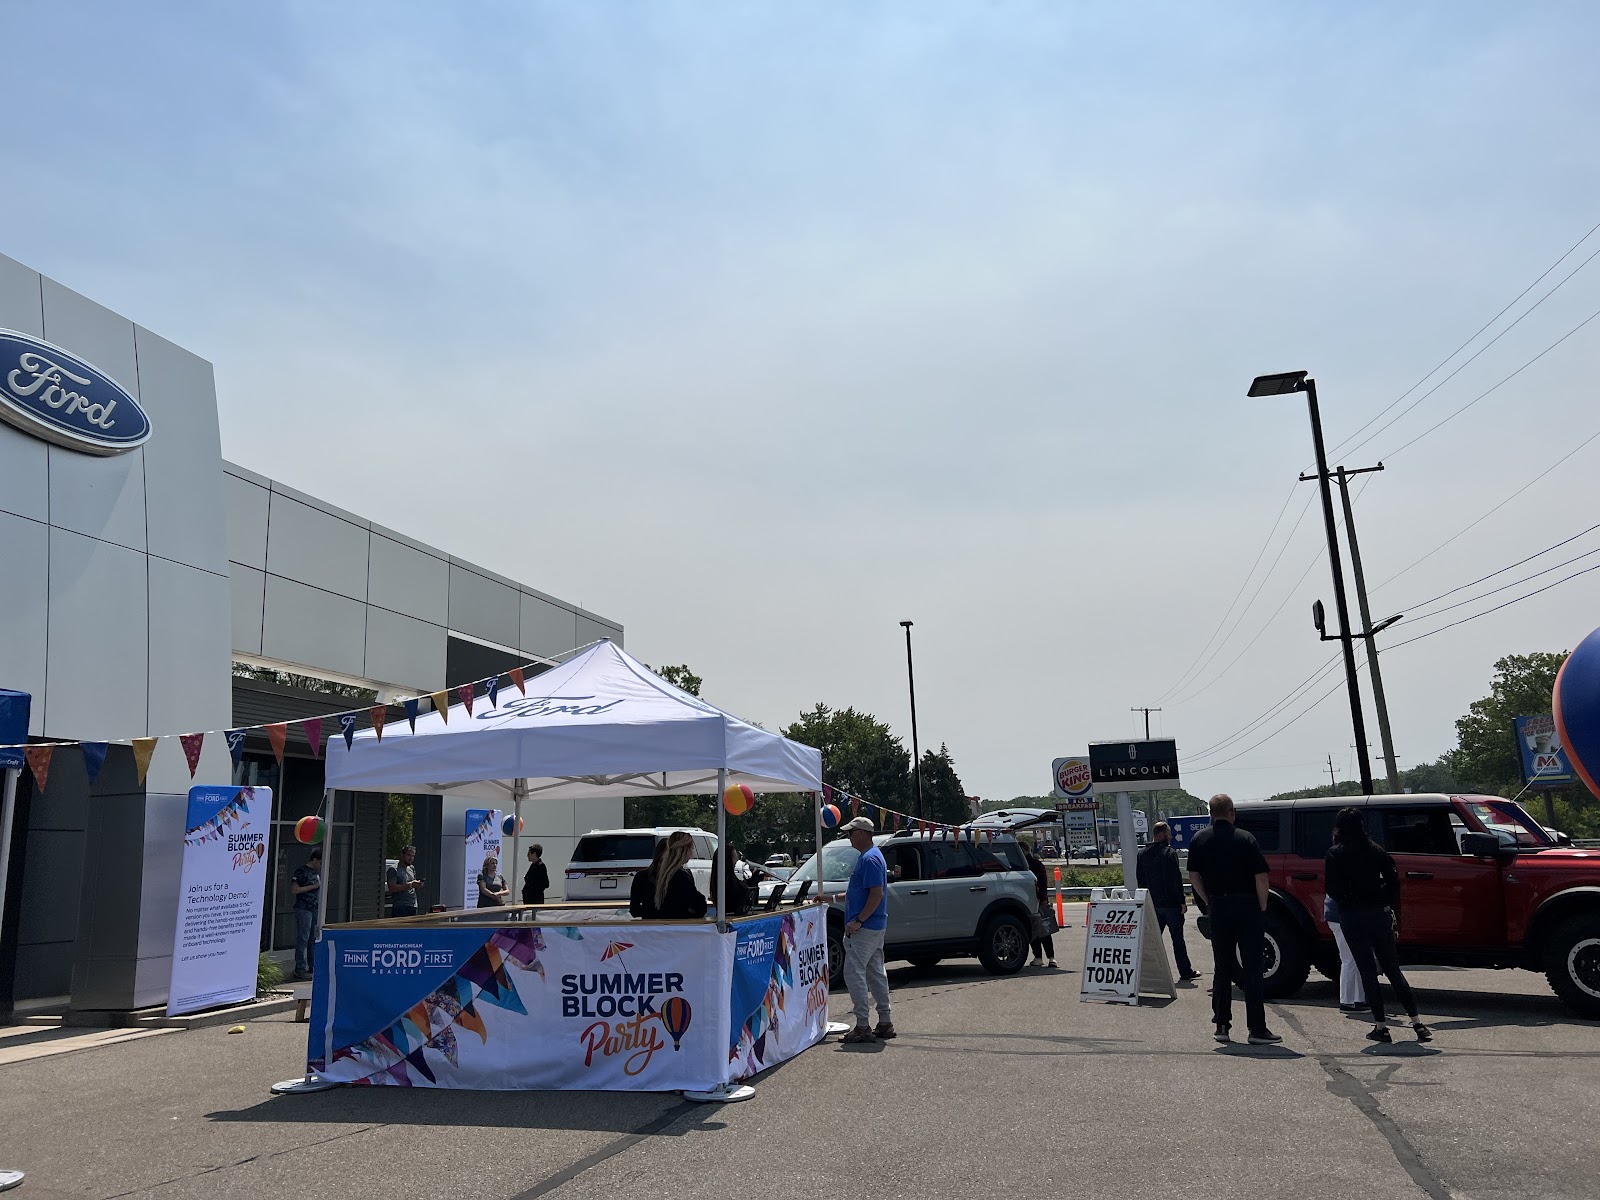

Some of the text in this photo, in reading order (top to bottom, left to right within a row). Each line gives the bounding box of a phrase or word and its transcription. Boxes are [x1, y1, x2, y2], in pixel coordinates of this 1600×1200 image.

[7, 352, 117, 430] Ford
[476, 695, 627, 720] Ford
[1060, 764, 1088, 779] BURGER
[1100, 765, 1171, 777] LINCOLN
[1061, 771, 1090, 788] KING
[228, 834, 264, 842] SUMMER
[228, 842, 256, 851] BLOCK
[232, 848, 257, 874] Party
[188, 884, 203, 893] Join
[214, 882, 223, 890] for
[188, 890, 250, 904] Technology Demo!
[1105, 910, 1135, 923] 97.1
[1093, 924, 1138, 935] TICKET
[344, 950, 453, 968] THINK FORD FIRST
[1092, 948, 1132, 964] HERE
[1086, 966, 1134, 985] TODAY
[561, 973, 684, 995] SUMMER
[562, 995, 656, 1018] BLOCK
[580, 1012, 664, 1076] Party
